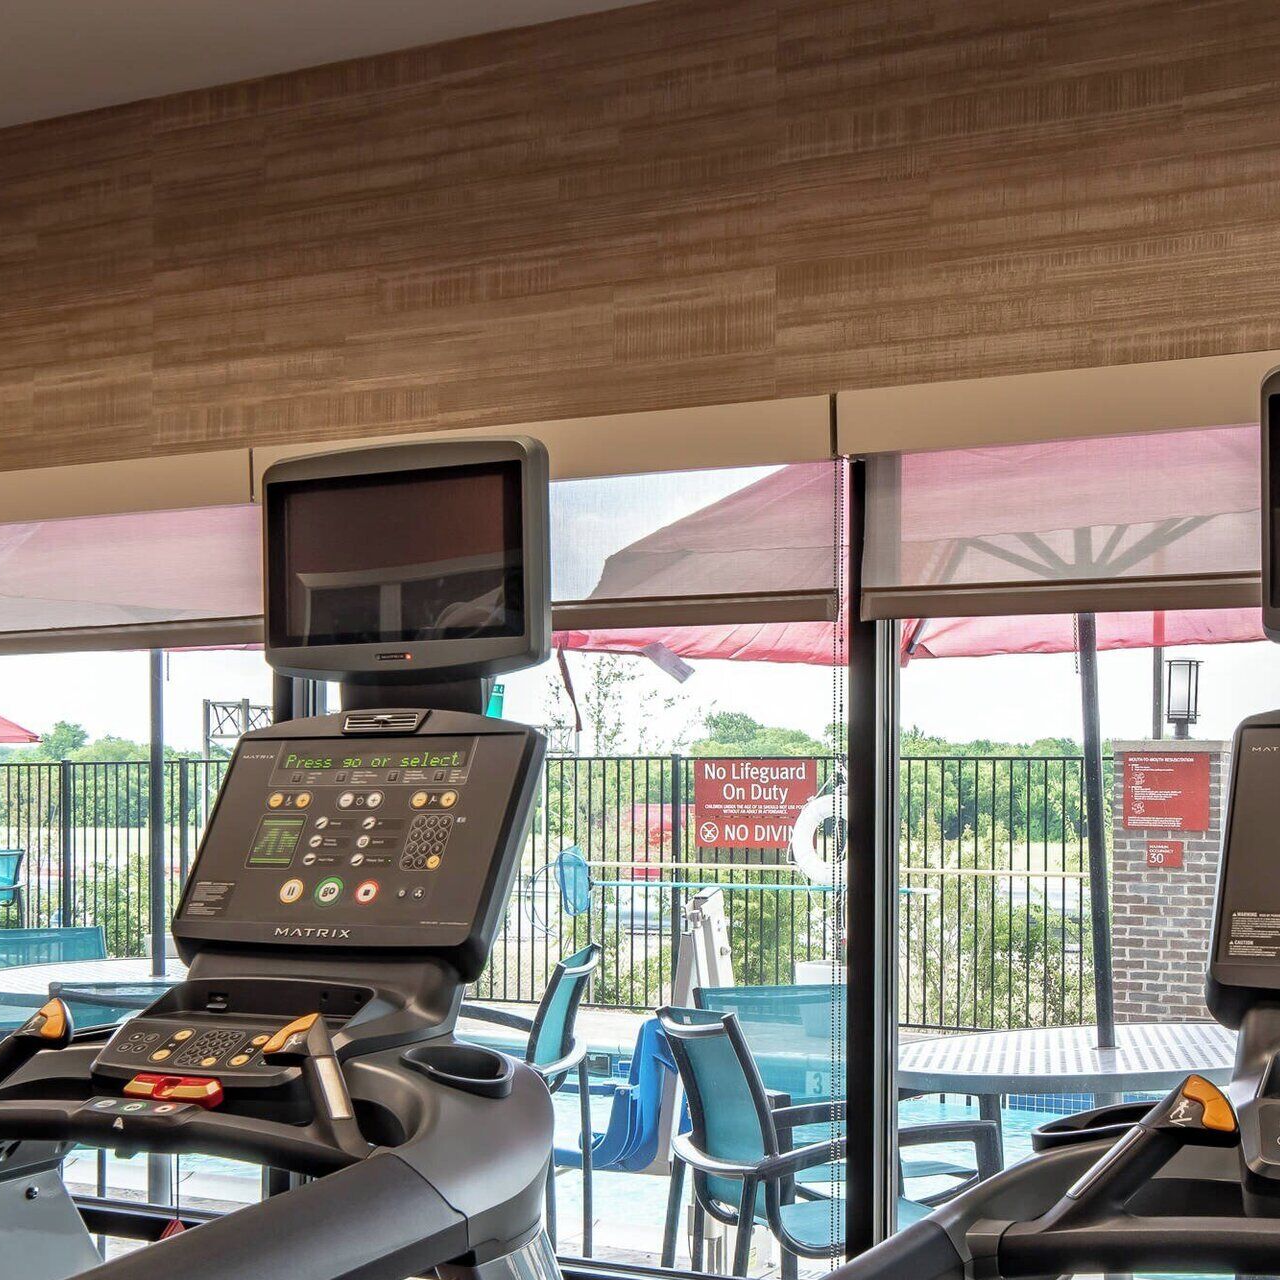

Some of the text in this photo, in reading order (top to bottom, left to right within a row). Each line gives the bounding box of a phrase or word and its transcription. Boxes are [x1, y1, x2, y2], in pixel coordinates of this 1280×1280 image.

[284, 754, 333, 769] Press
[371, 758, 391, 767] or
[400, 751, 460, 767] select
[704, 762, 806, 783] No Lifeguard
[723, 783, 789, 804] On Duty
[724, 824, 795, 843] NO DIVIN
[1149, 853, 1164, 864] 30
[322, 886, 336, 897] go
[274, 927, 351, 939] MATRIX
[813, 1073, 823, 1094] 3
